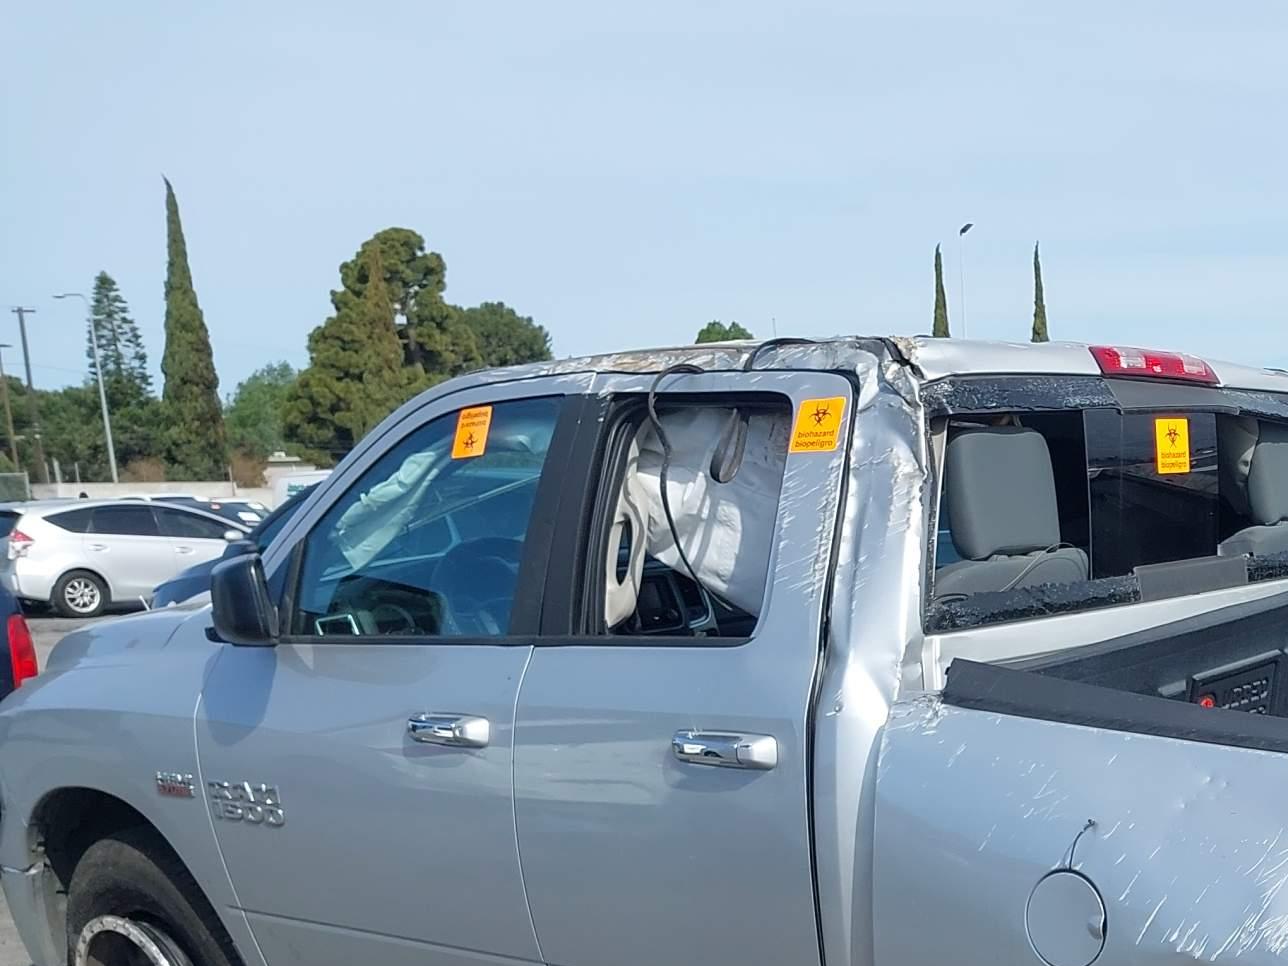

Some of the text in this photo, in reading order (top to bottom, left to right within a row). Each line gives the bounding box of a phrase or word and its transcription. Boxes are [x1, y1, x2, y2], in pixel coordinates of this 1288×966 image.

[797, 429, 834, 438] biohazard
[795, 439, 833, 448] biopeligro
[207, 780, 281, 806] RAM
[211, 798, 286, 828] 1500
